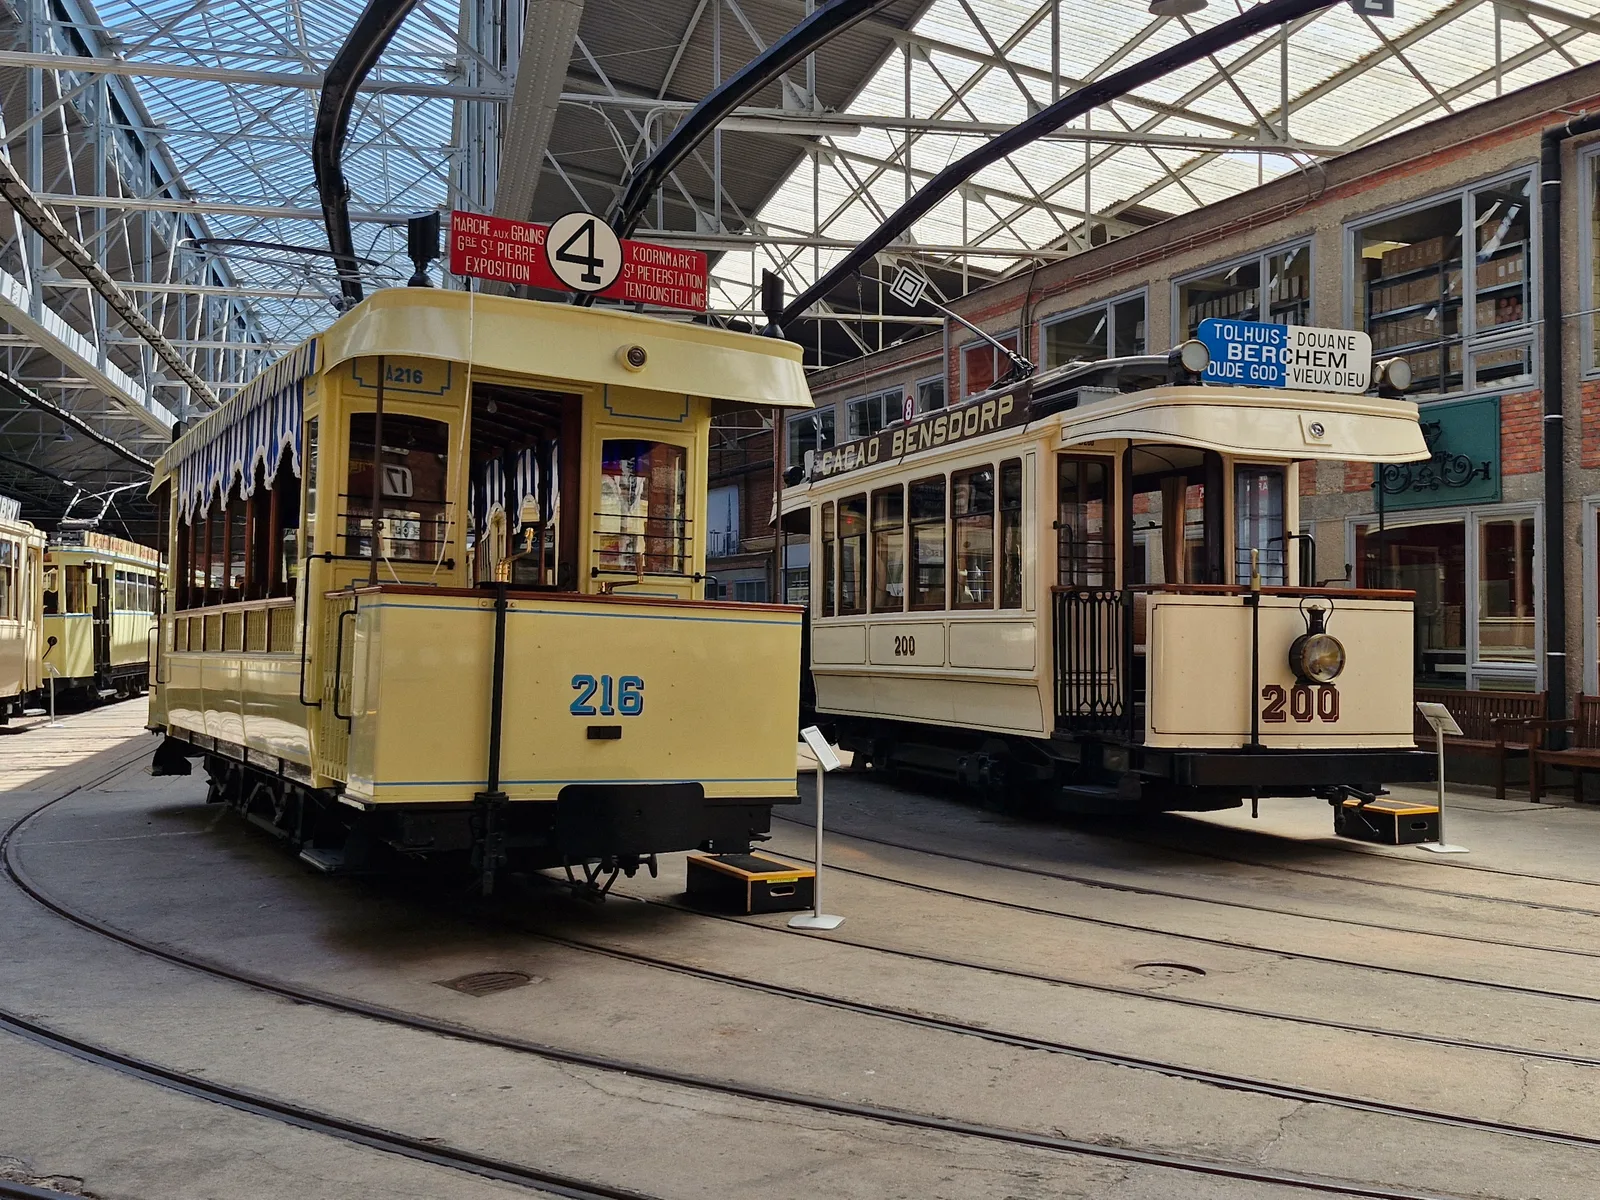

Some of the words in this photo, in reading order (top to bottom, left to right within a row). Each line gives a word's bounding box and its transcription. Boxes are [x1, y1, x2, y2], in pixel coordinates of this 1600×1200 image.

[453, 216, 492, 237] MARCHE
[493, 229, 509, 239] AUX
[511, 225, 545, 246] GRAINS
[497, 241, 536, 263] PIERRE
[555, 218, 605, 285] 4
[632, 245, 698, 271] KOORNMARKT
[465, 255, 530, 282] EXPOSITION
[637, 264, 703, 290] PIETERSTATION
[624, 281, 705, 308] TENTOONSTELLING
[1297, 331, 1356, 351] DOUANE
[1227, 342, 1348, 369] BERCHEM
[1207, 360, 1244, 379] OUDE
[1250, 363, 1278, 381] GOD
[1293, 368, 1331, 386] VIEUX
[1334, 371, 1365, 388] DIEU
[904, 398, 914, 421] 8
[821, 437, 880, 476] CACAO
[891, 394, 1014, 458] BENSDORP
[894, 634, 916, 657] 200
[569, 673, 646, 717] 216
[1260, 683, 1341, 724] 200
